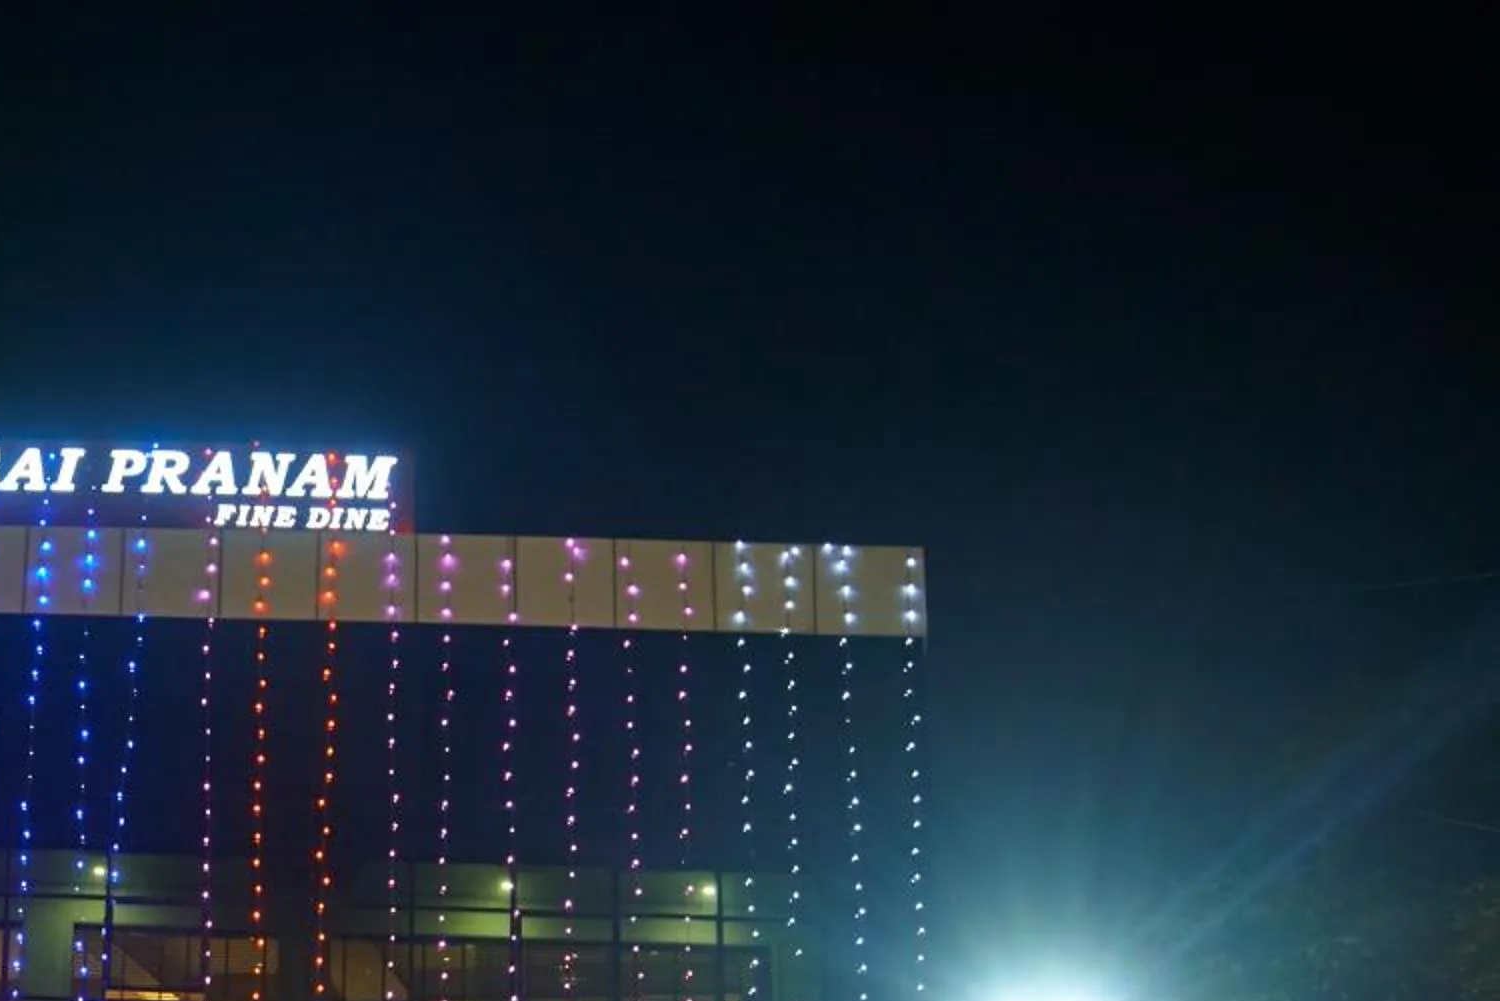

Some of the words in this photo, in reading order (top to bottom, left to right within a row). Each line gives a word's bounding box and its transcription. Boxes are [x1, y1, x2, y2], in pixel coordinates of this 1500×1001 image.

[101, 450, 398, 499] PRANAM
[214, 504, 296, 528] FINE
[304, 505, 391, 531] DINE
